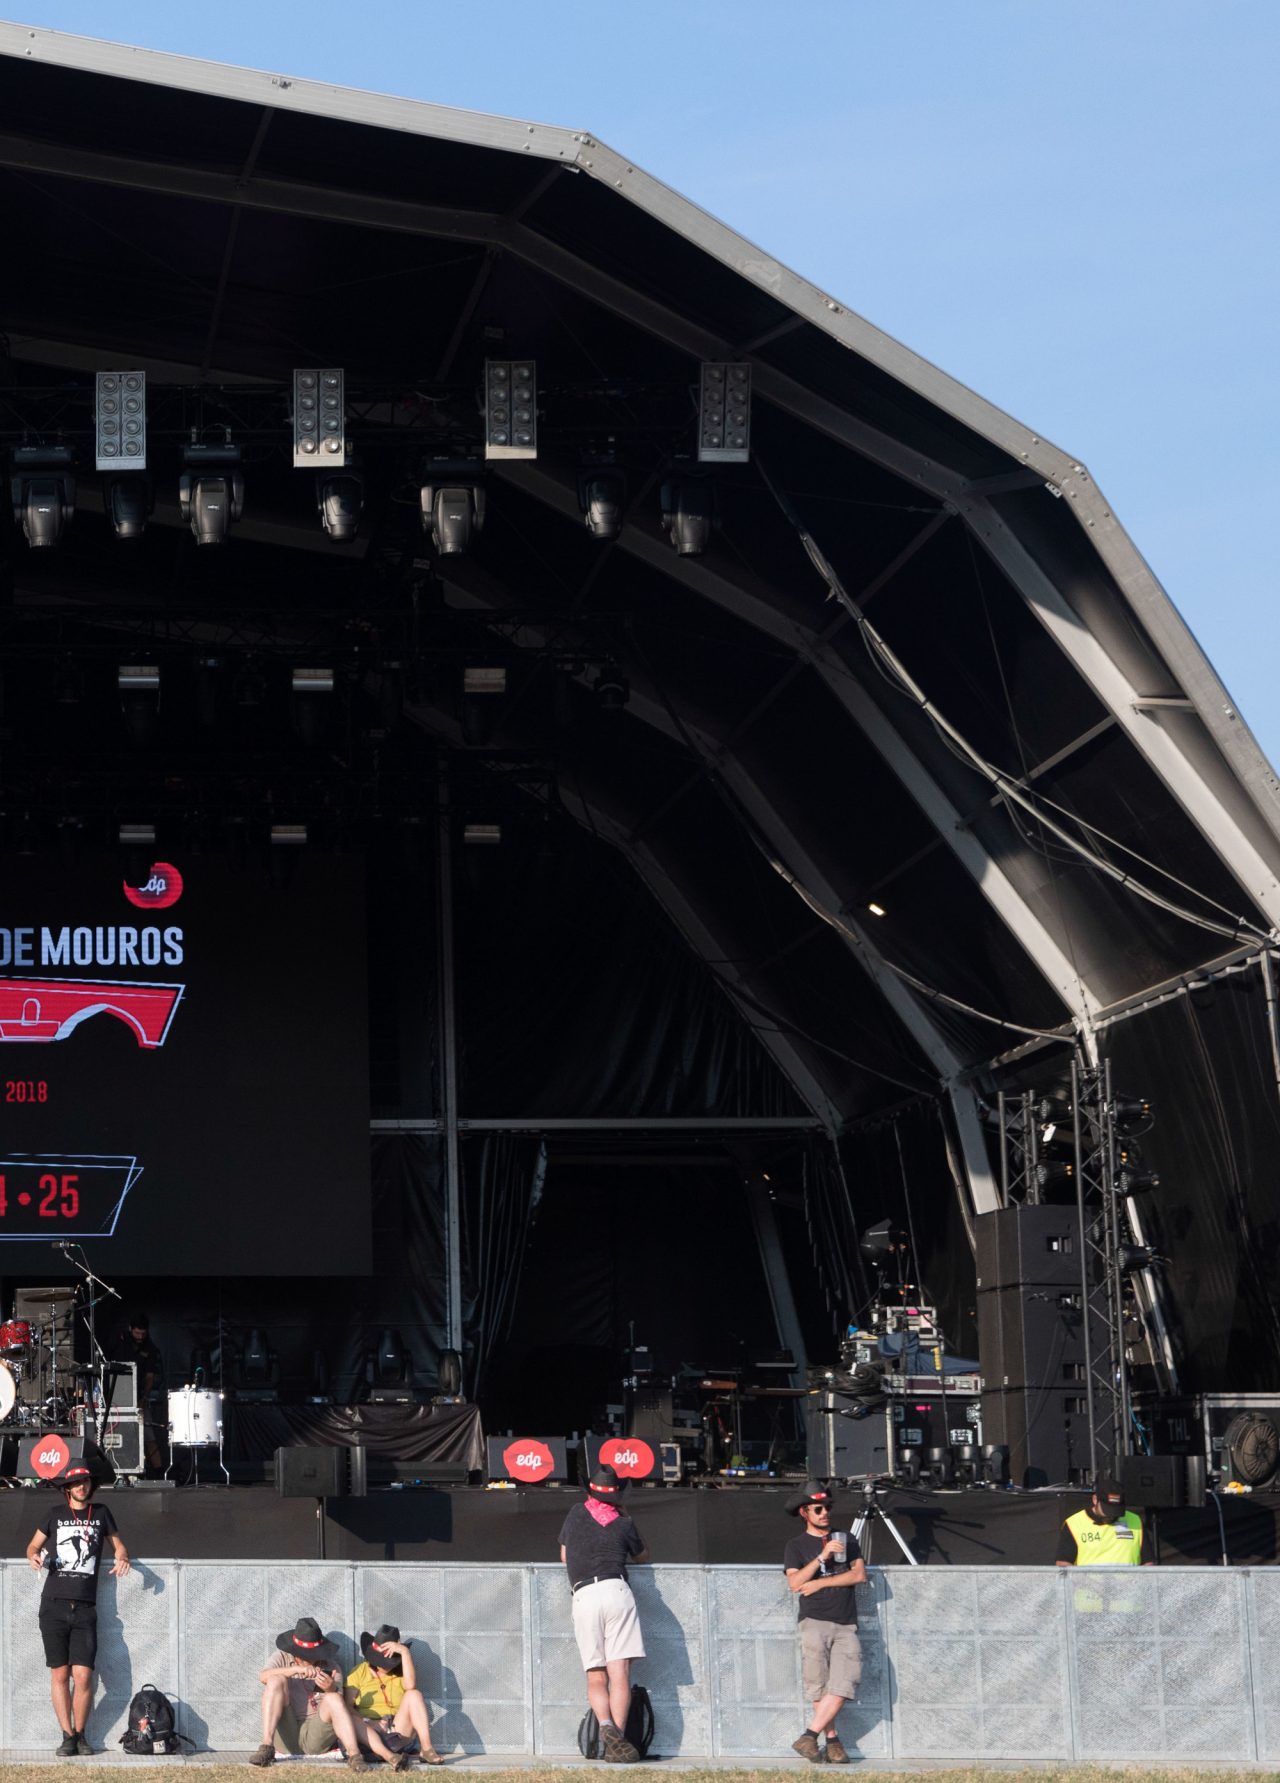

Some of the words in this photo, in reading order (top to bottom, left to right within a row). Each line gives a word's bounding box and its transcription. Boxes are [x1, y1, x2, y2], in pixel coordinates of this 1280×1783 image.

[41, 927, 184, 966] MOUROS
[6, 1081, 48, 1103] 2018
[38, 1174, 79, 1217] 25
[39, 1448, 61, 1467] edp
[515, 1451, 542, 1470] edp
[614, 1449, 638, 1468] edp
[57, 1518, 101, 1527] bauhaus
[1081, 1532, 1101, 1543] 084
